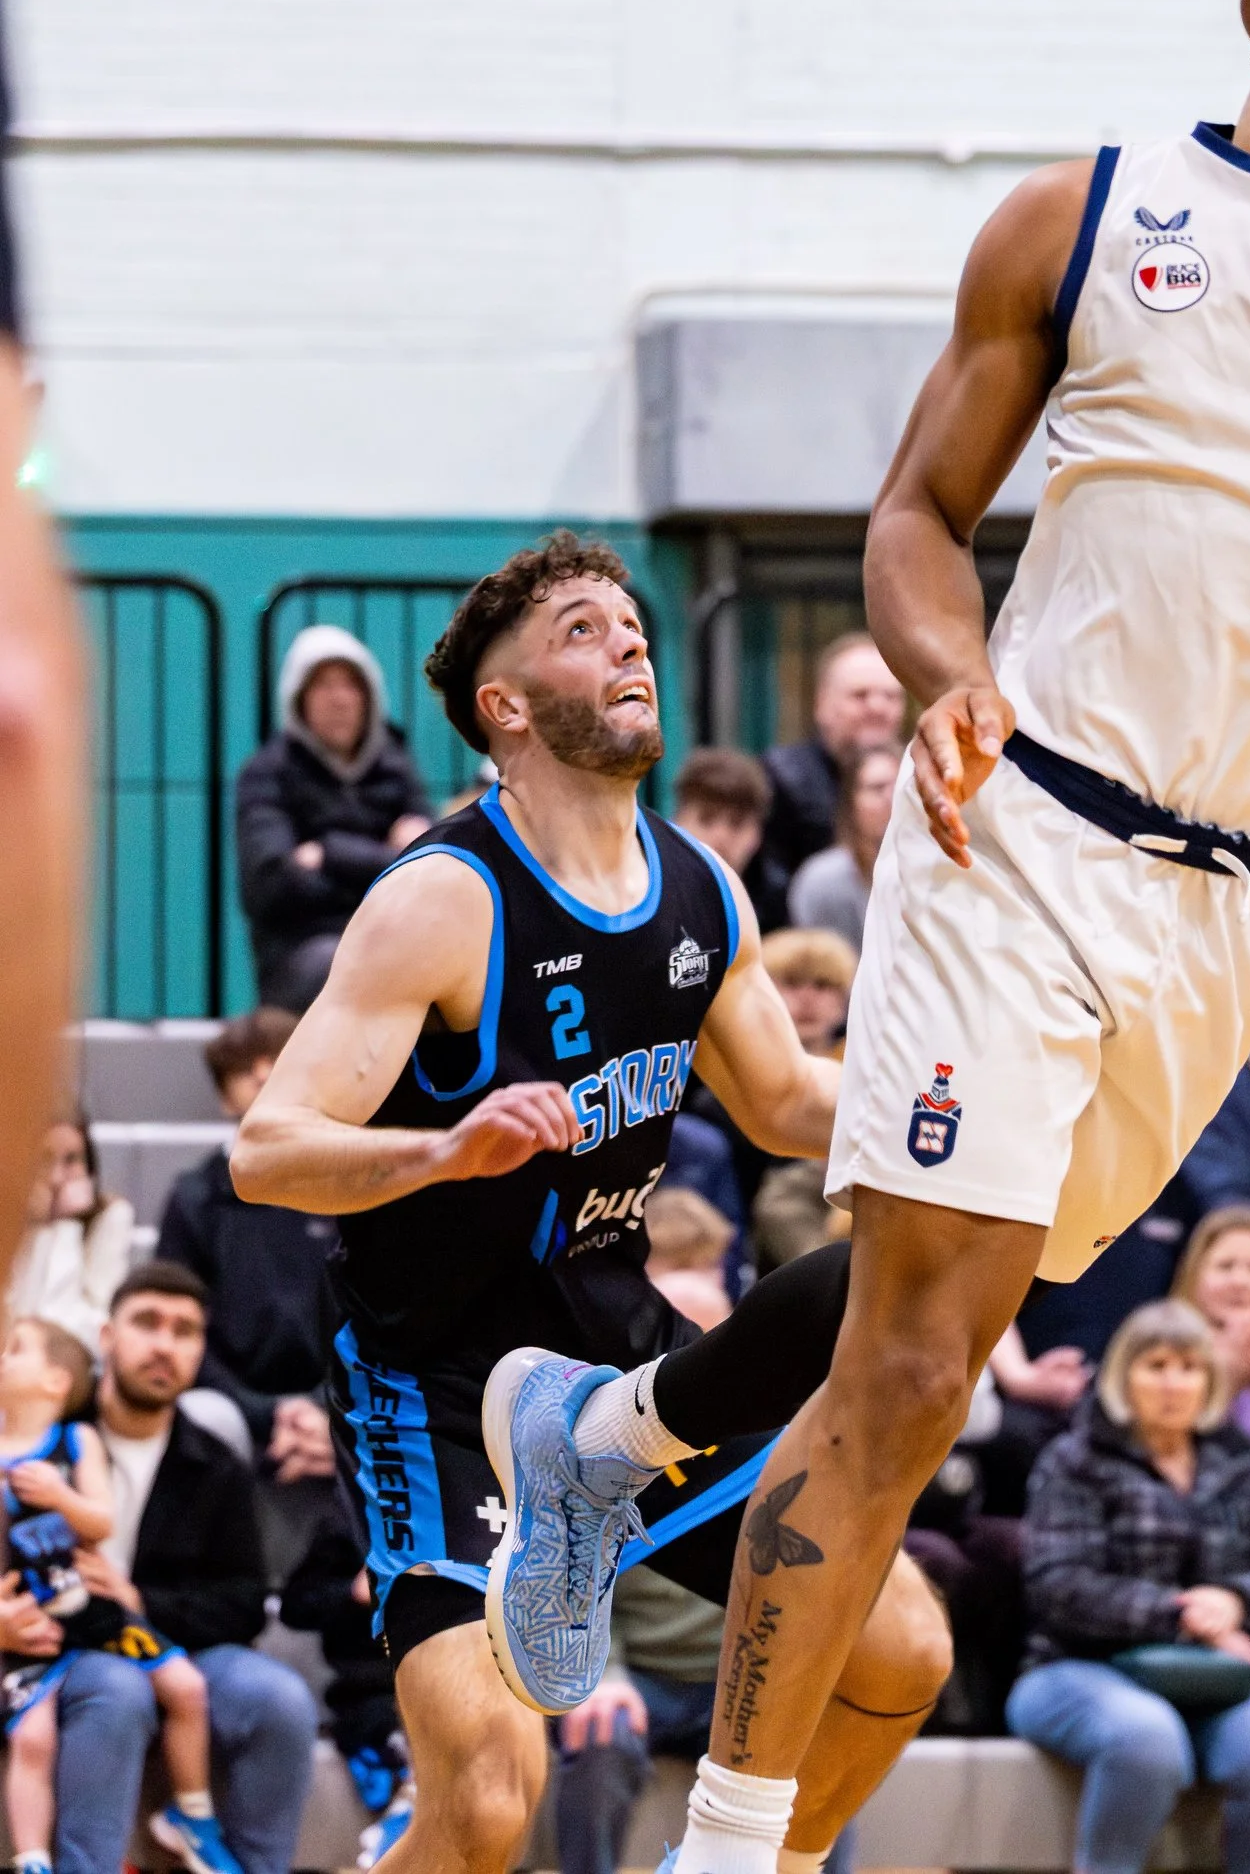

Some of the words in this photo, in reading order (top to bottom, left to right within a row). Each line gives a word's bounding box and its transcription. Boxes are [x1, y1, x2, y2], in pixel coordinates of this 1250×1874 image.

[533, 953, 583, 979] TMB
[546, 983, 592, 1060] 2
[750, 1599, 783, 1647] My
